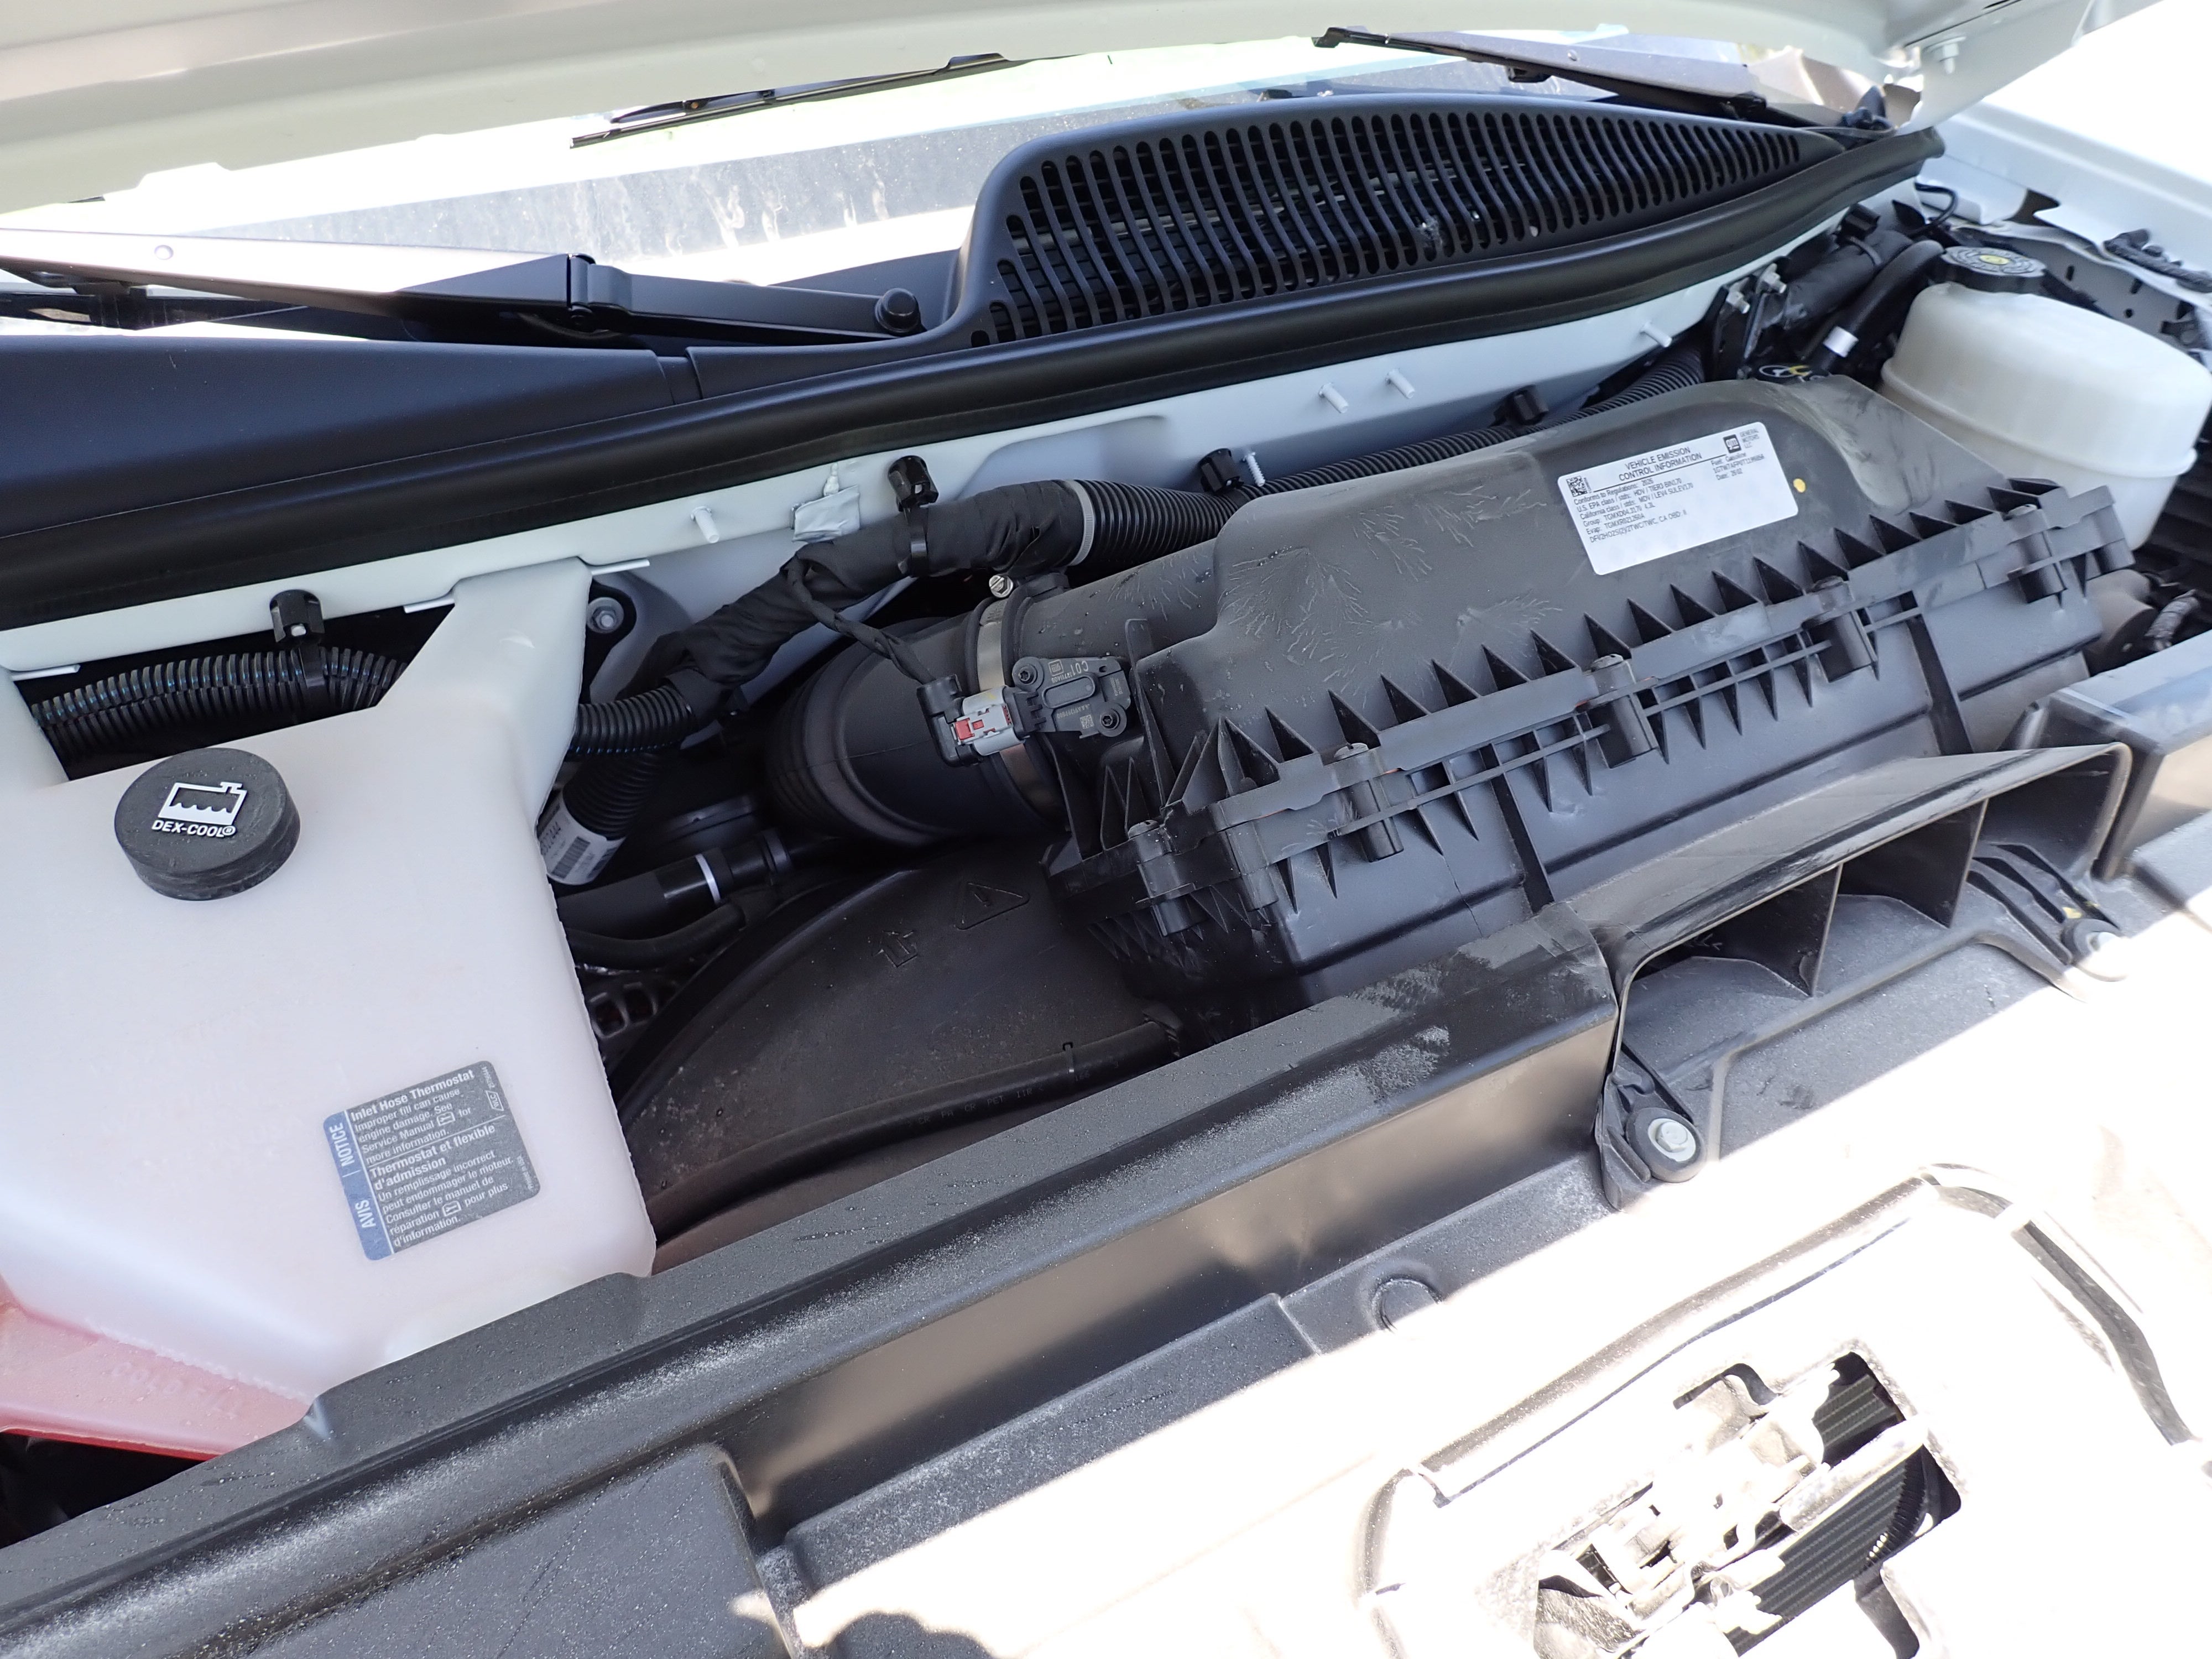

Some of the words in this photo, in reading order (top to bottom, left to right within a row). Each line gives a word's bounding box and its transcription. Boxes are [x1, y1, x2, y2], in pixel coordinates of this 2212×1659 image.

[1618, 465, 1654, 482] CONTROL
[1653, 451, 1703, 472] INFORMATION
[1624, 455, 1657, 471] VEHICLE
[1656, 446, 1691, 462] EMISSION
[1573, 492, 1600, 505] Conforms
[1576, 504, 1588, 513] U.S.
[1588, 500, 1601, 509] EPA
[1600, 496, 1615, 506] class
[1579, 507, 1606, 520] California
[1605, 503, 1620, 513] class
[1582, 517, 1601, 528] Group:
[1585, 525, 1602, 536] Evap:
[1657, 514, 1668, 523] CA
[349, 1103, 378, 1121] Inlet
[378, 1092, 409, 1111] Hose
[409, 1068, 475, 1100] Thermostat
[354, 1109, 399, 1134] Improper
[399, 1104, 413, 1116] fill
[413, 1098, 431, 1111] can
[432, 1088, 461, 1104] cause
[987, 1094, 1004, 1106] PET
[357, 1124, 392, 1145] engine
[391, 1108, 434, 1132] damage.
[432, 1100, 453, 1115] See
[361, 1133, 399, 1154] Service
[398, 1119, 435, 1140] Manual
[457, 1105, 473, 1118] for
[328, 1121, 356, 1167] NOTICE
[365, 1149, 392, 1165] more
[391, 1125, 450, 1155] information.
[369, 1145, 439, 1179] Thermostat
[438, 1140, 452, 1152] et
[452, 1122, 497, 1147] flexible
[373, 1154, 447, 1191] d'admission
[377, 1188, 393, 1202] Un
[392, 1166, 453, 1198] remplissage
[452, 1149, 496, 1173] incorrect
[381, 1197, 405, 1215] peut
[404, 1173, 467, 1206] endommager
[467, 1168, 478, 1179] le
[478, 1154, 514, 1175] moteur.
[354, 1198, 377, 1231] AVIS
[385, 1198, 433, 1225] Consulter
[432, 1194, 444, 1206] le
[444, 1180, 481, 1202] manuel
[481, 1174, 494, 1186] de
[388, 1207, 440, 1237] réparation
[463, 1191, 488, 1208] pour
[487, 1181, 510, 1198] plus
[392, 1212, 462, 1248] d'information.
